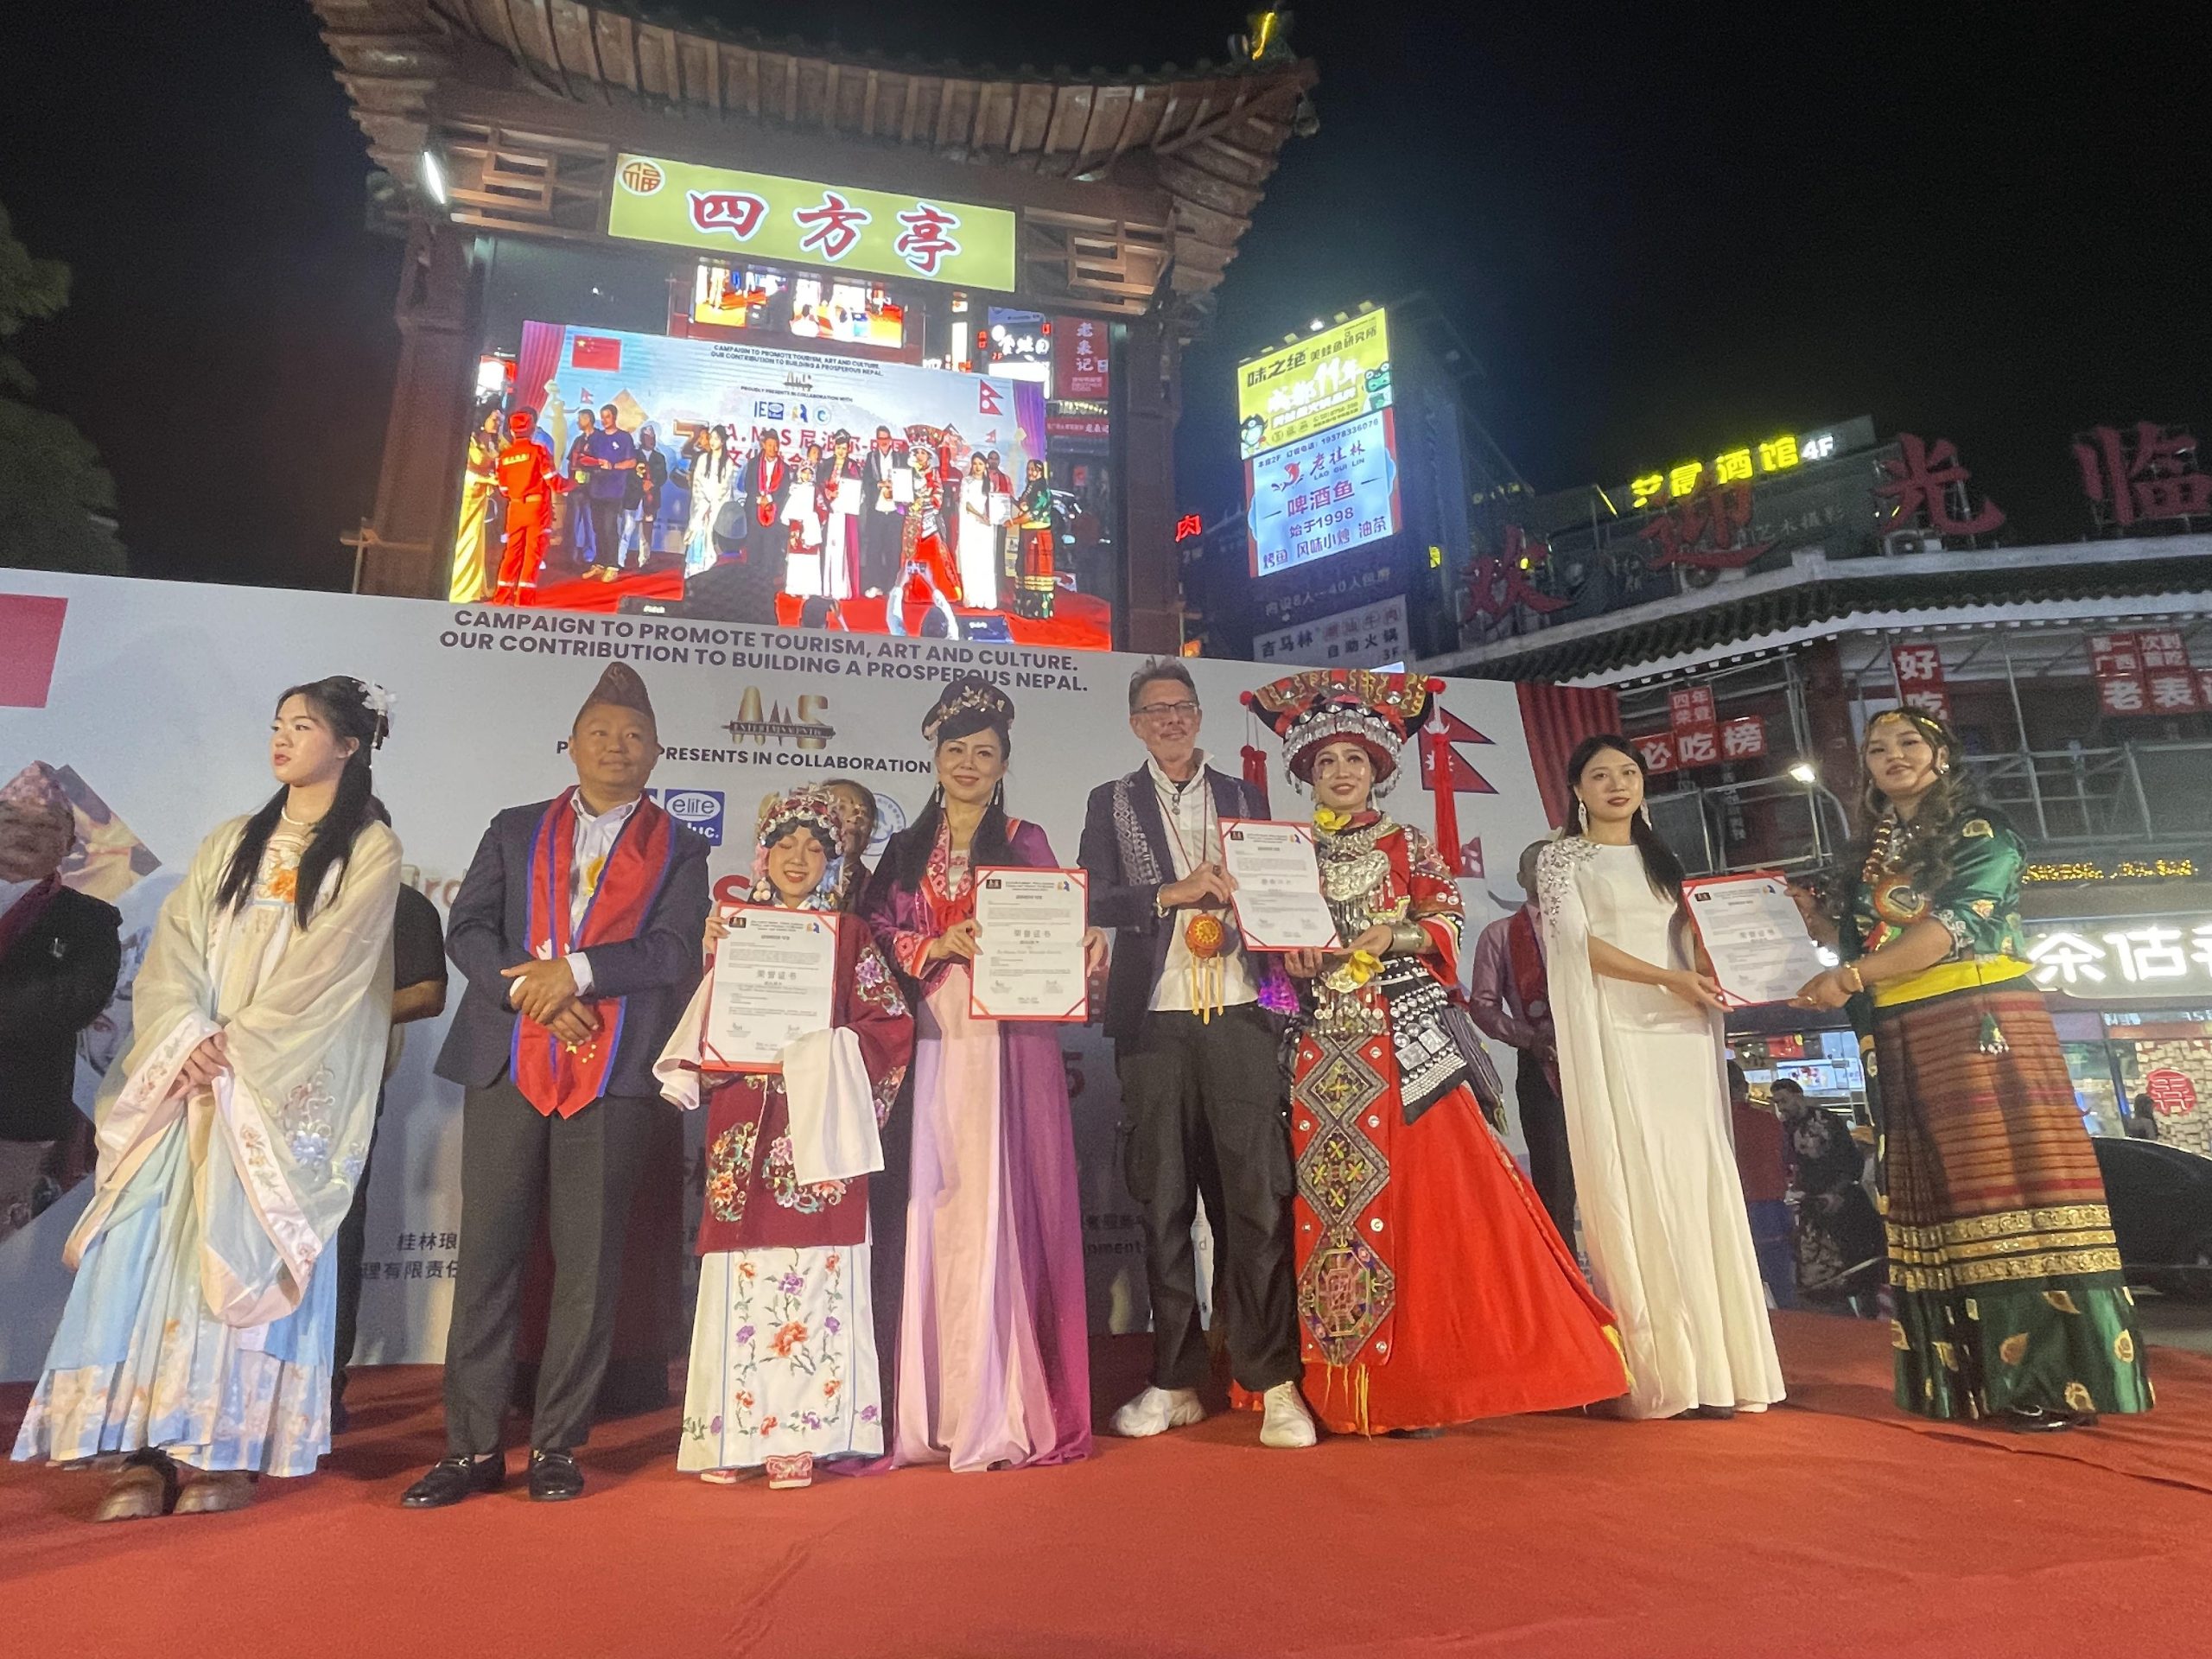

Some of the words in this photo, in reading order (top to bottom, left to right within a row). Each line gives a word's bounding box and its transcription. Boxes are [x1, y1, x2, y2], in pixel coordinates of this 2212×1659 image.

[621, 162, 660, 193] 福
[688, 192, 959, 274] 四方亭
[711, 351, 724, 359] OUR
[726, 353, 775, 364] CONTRIBUTION
[785, 359, 814, 369] BUILDING
[822, 364, 861, 373] PROSPEROUS
[714, 345, 750, 356] CAMPAIGN
[761, 350, 791, 359] PROMOTE
[1248, 349, 1306, 387] 味之绝
[797, 392, 838, 402] COLLABORATION
[1311, 440, 1366, 475] 老桂林
[1802, 436, 1834, 460] 4F
[1314, 470, 1329, 480] LAO
[1333, 465, 1347, 474] GUI
[1351, 458, 1365, 467] LIN
[1287, 480, 1355, 517] 啤酒鱼
[1176, 515, 1202, 542] 肉
[1289, 507, 1354, 537] 始于1998
[1263, 550, 1287, 569] 烤鱼
[1297, 528, 1350, 557] 风味小炒
[1358, 516, 1387, 538] 油茶
[454, 609, 594, 635] CAMPAIGN
[601, 620, 634, 638] TO
[639, 623, 756, 647] PROMOTE
[760, 632, 871, 659] TOURISM,
[877, 642, 921, 660] ART
[925, 645, 974, 663] AND
[978, 649, 1078, 671] CULTURE.
[440, 631, 494, 650] OUR
[499, 635, 689, 664] CONTRIBUTION
[695, 648, 727, 666] TO
[732, 650, 841, 674] BUILDING
[845, 660, 861, 677] A
[867, 661, 1011, 687] PROSPEROUS
[1016, 672, 1088, 691] NEPAL.
[1673, 691, 1709, 709] 四年
[1897, 651, 1948, 720] 好吃
[2103, 677, 2212, 710] 老表
[1641, 722, 1762, 770] 必吃榜
[753, 750, 772, 765] IN
[777, 753, 931, 774] COLLABORATION
[671, 798, 715, 814] elite
[397, 1232, 458, 1251] 桂林琅
